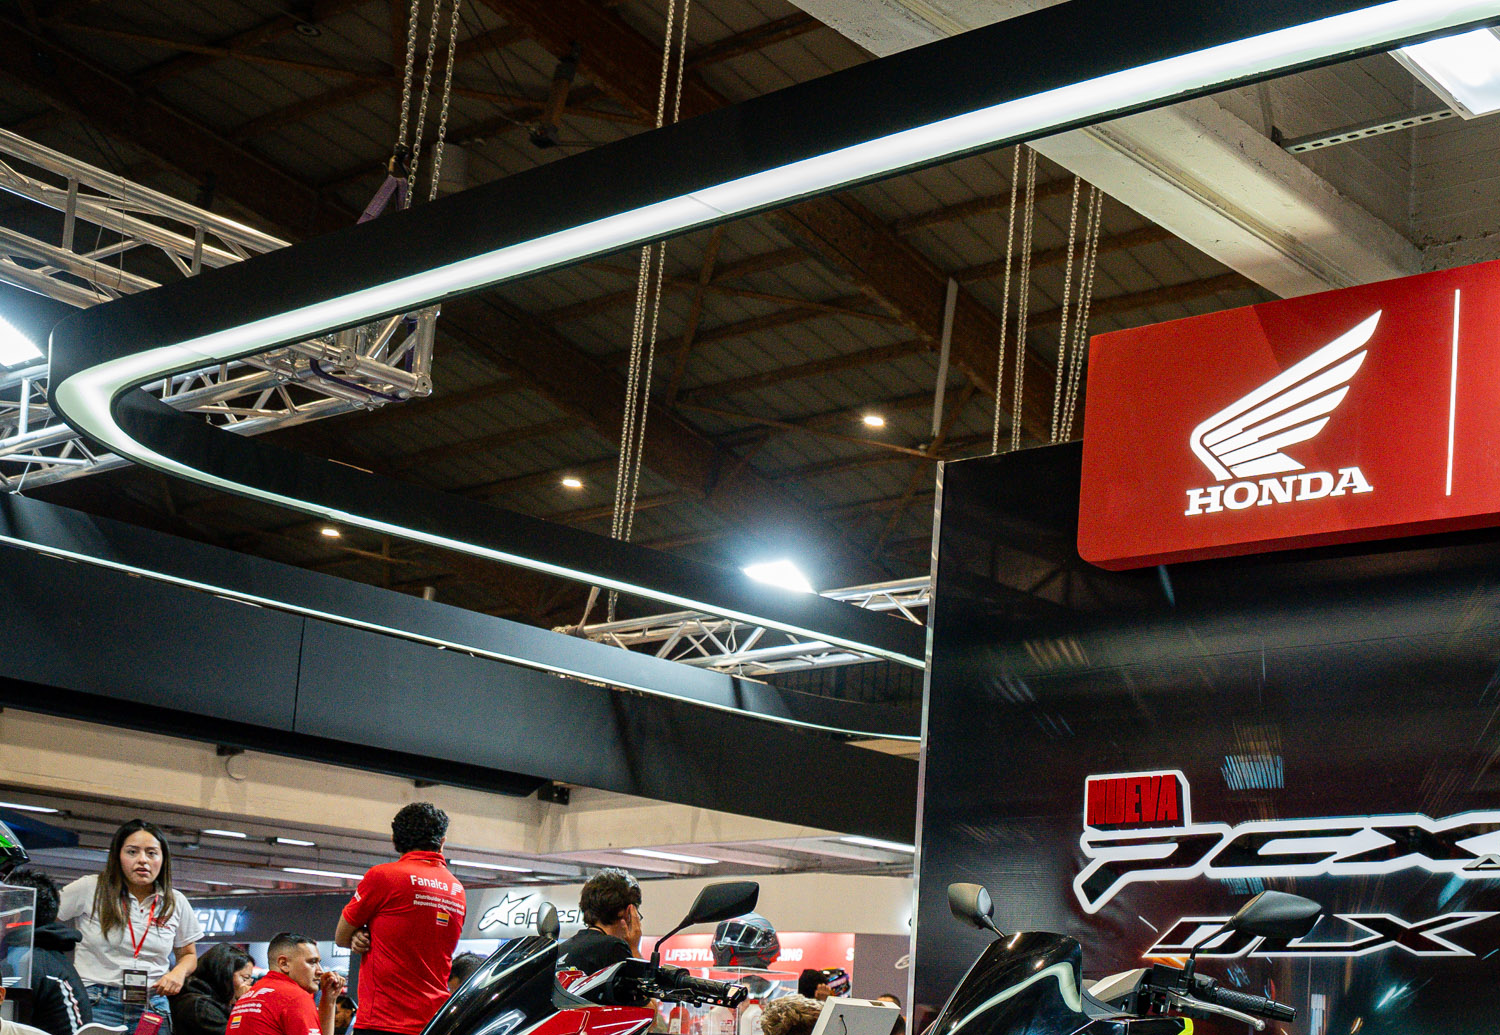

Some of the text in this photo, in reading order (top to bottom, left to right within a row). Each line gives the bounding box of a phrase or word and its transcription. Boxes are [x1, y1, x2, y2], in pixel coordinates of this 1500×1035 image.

[1185, 466, 1373, 516] HONDA
[1087, 773, 1180, 828] NUEVA
[410, 875, 449, 891] Fanalca
